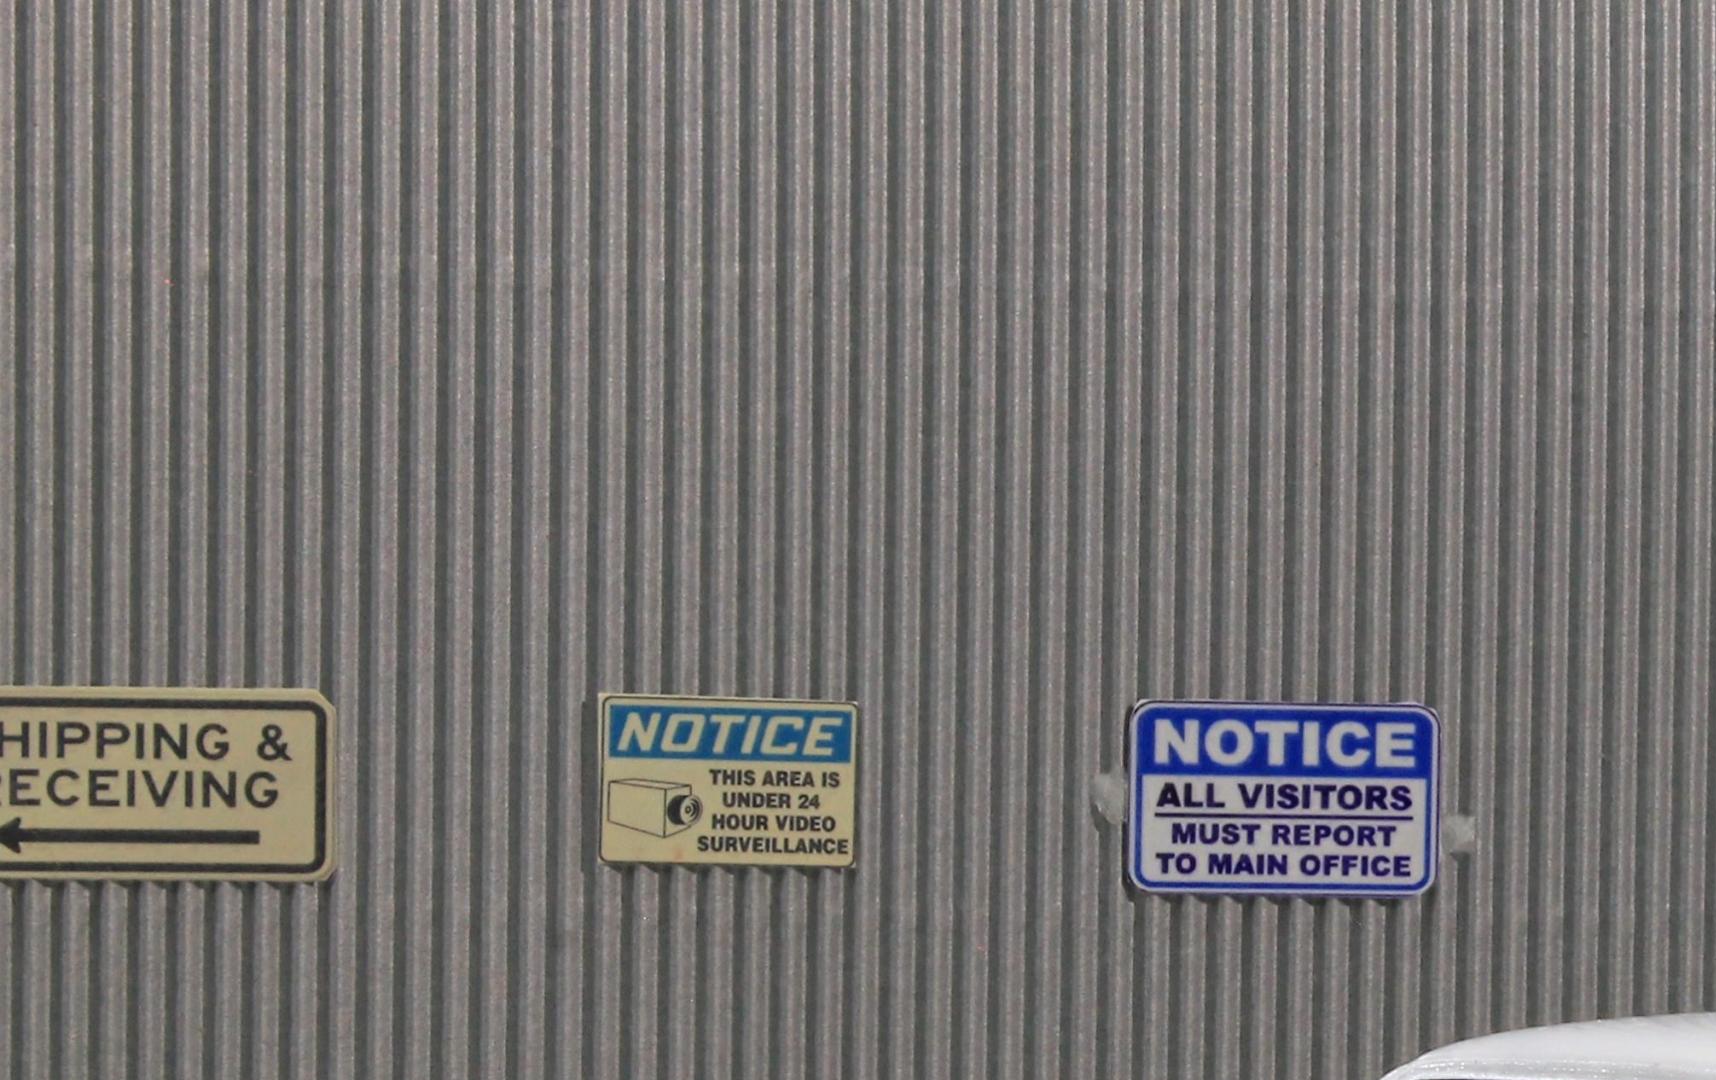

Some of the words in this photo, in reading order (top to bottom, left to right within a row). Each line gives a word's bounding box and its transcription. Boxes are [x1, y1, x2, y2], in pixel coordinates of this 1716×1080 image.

[257, 724, 292, 761] &
[617, 711, 843, 756] NOTICE
[1154, 718, 1416, 768] NOTICE
[0, 768, 279, 808] ECEIVING
[709, 769, 755, 786] THIS
[762, 770, 815, 787] AREA
[822, 772, 840, 787] IS
[722, 792, 791, 809] UNDER
[798, 794, 820, 810] 24
[1156, 782, 1225, 808] ALL
[1238, 783, 1413, 811] VISITORS
[712, 814, 768, 831] HOUR
[776, 815, 836, 832] VIDEO
[1171, 823, 1261, 845] MUST
[1271, 825, 1396, 847] REPORT
[697, 836, 849, 855] SURVEILLANCE
[1156, 853, 1196, 875] TO
[1208, 853, 1288, 876] MAIN
[1299, 855, 1411, 877] OFFICE
